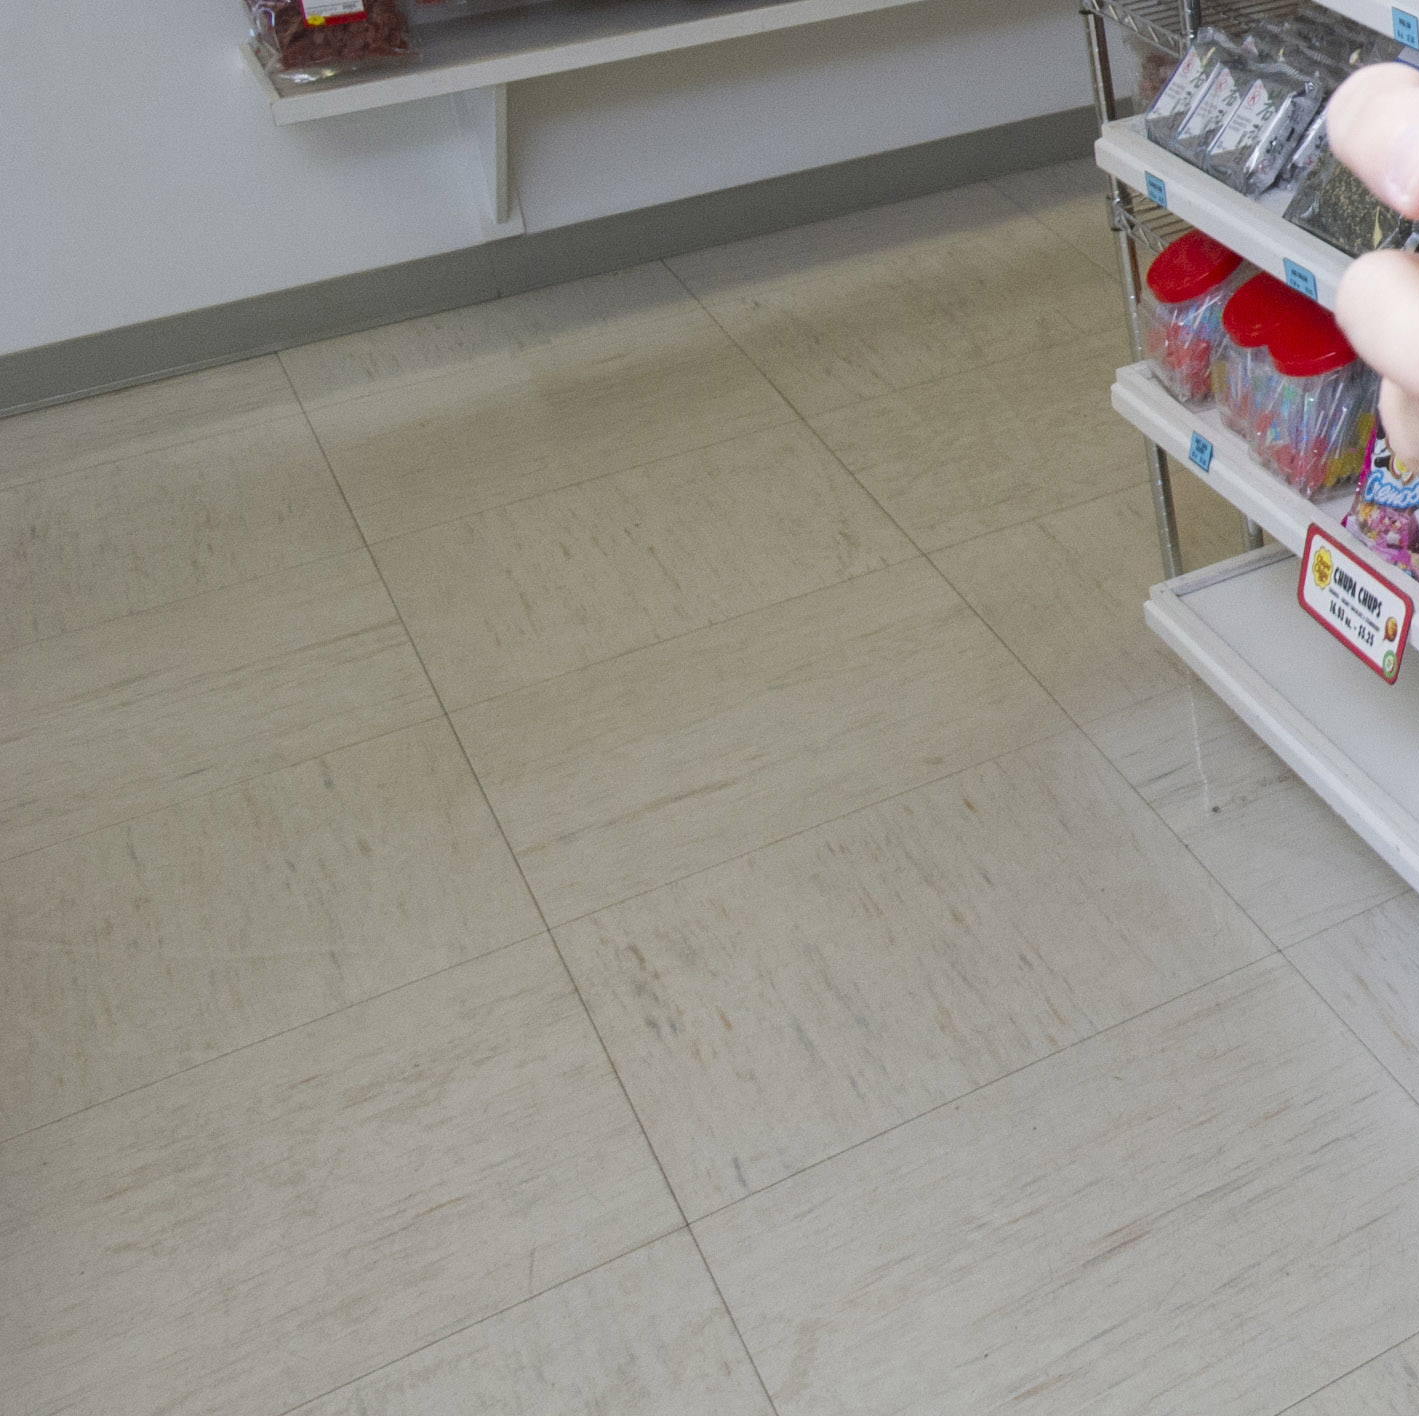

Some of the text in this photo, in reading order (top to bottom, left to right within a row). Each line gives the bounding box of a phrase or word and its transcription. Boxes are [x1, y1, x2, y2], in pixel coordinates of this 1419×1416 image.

[1333, 566, 1357, 599] CHUPA
[1358, 586, 1383, 619] CHUPS
[1329, 599, 1345, 622] 16.93
[1357, 624, 1375, 647] $5.25
